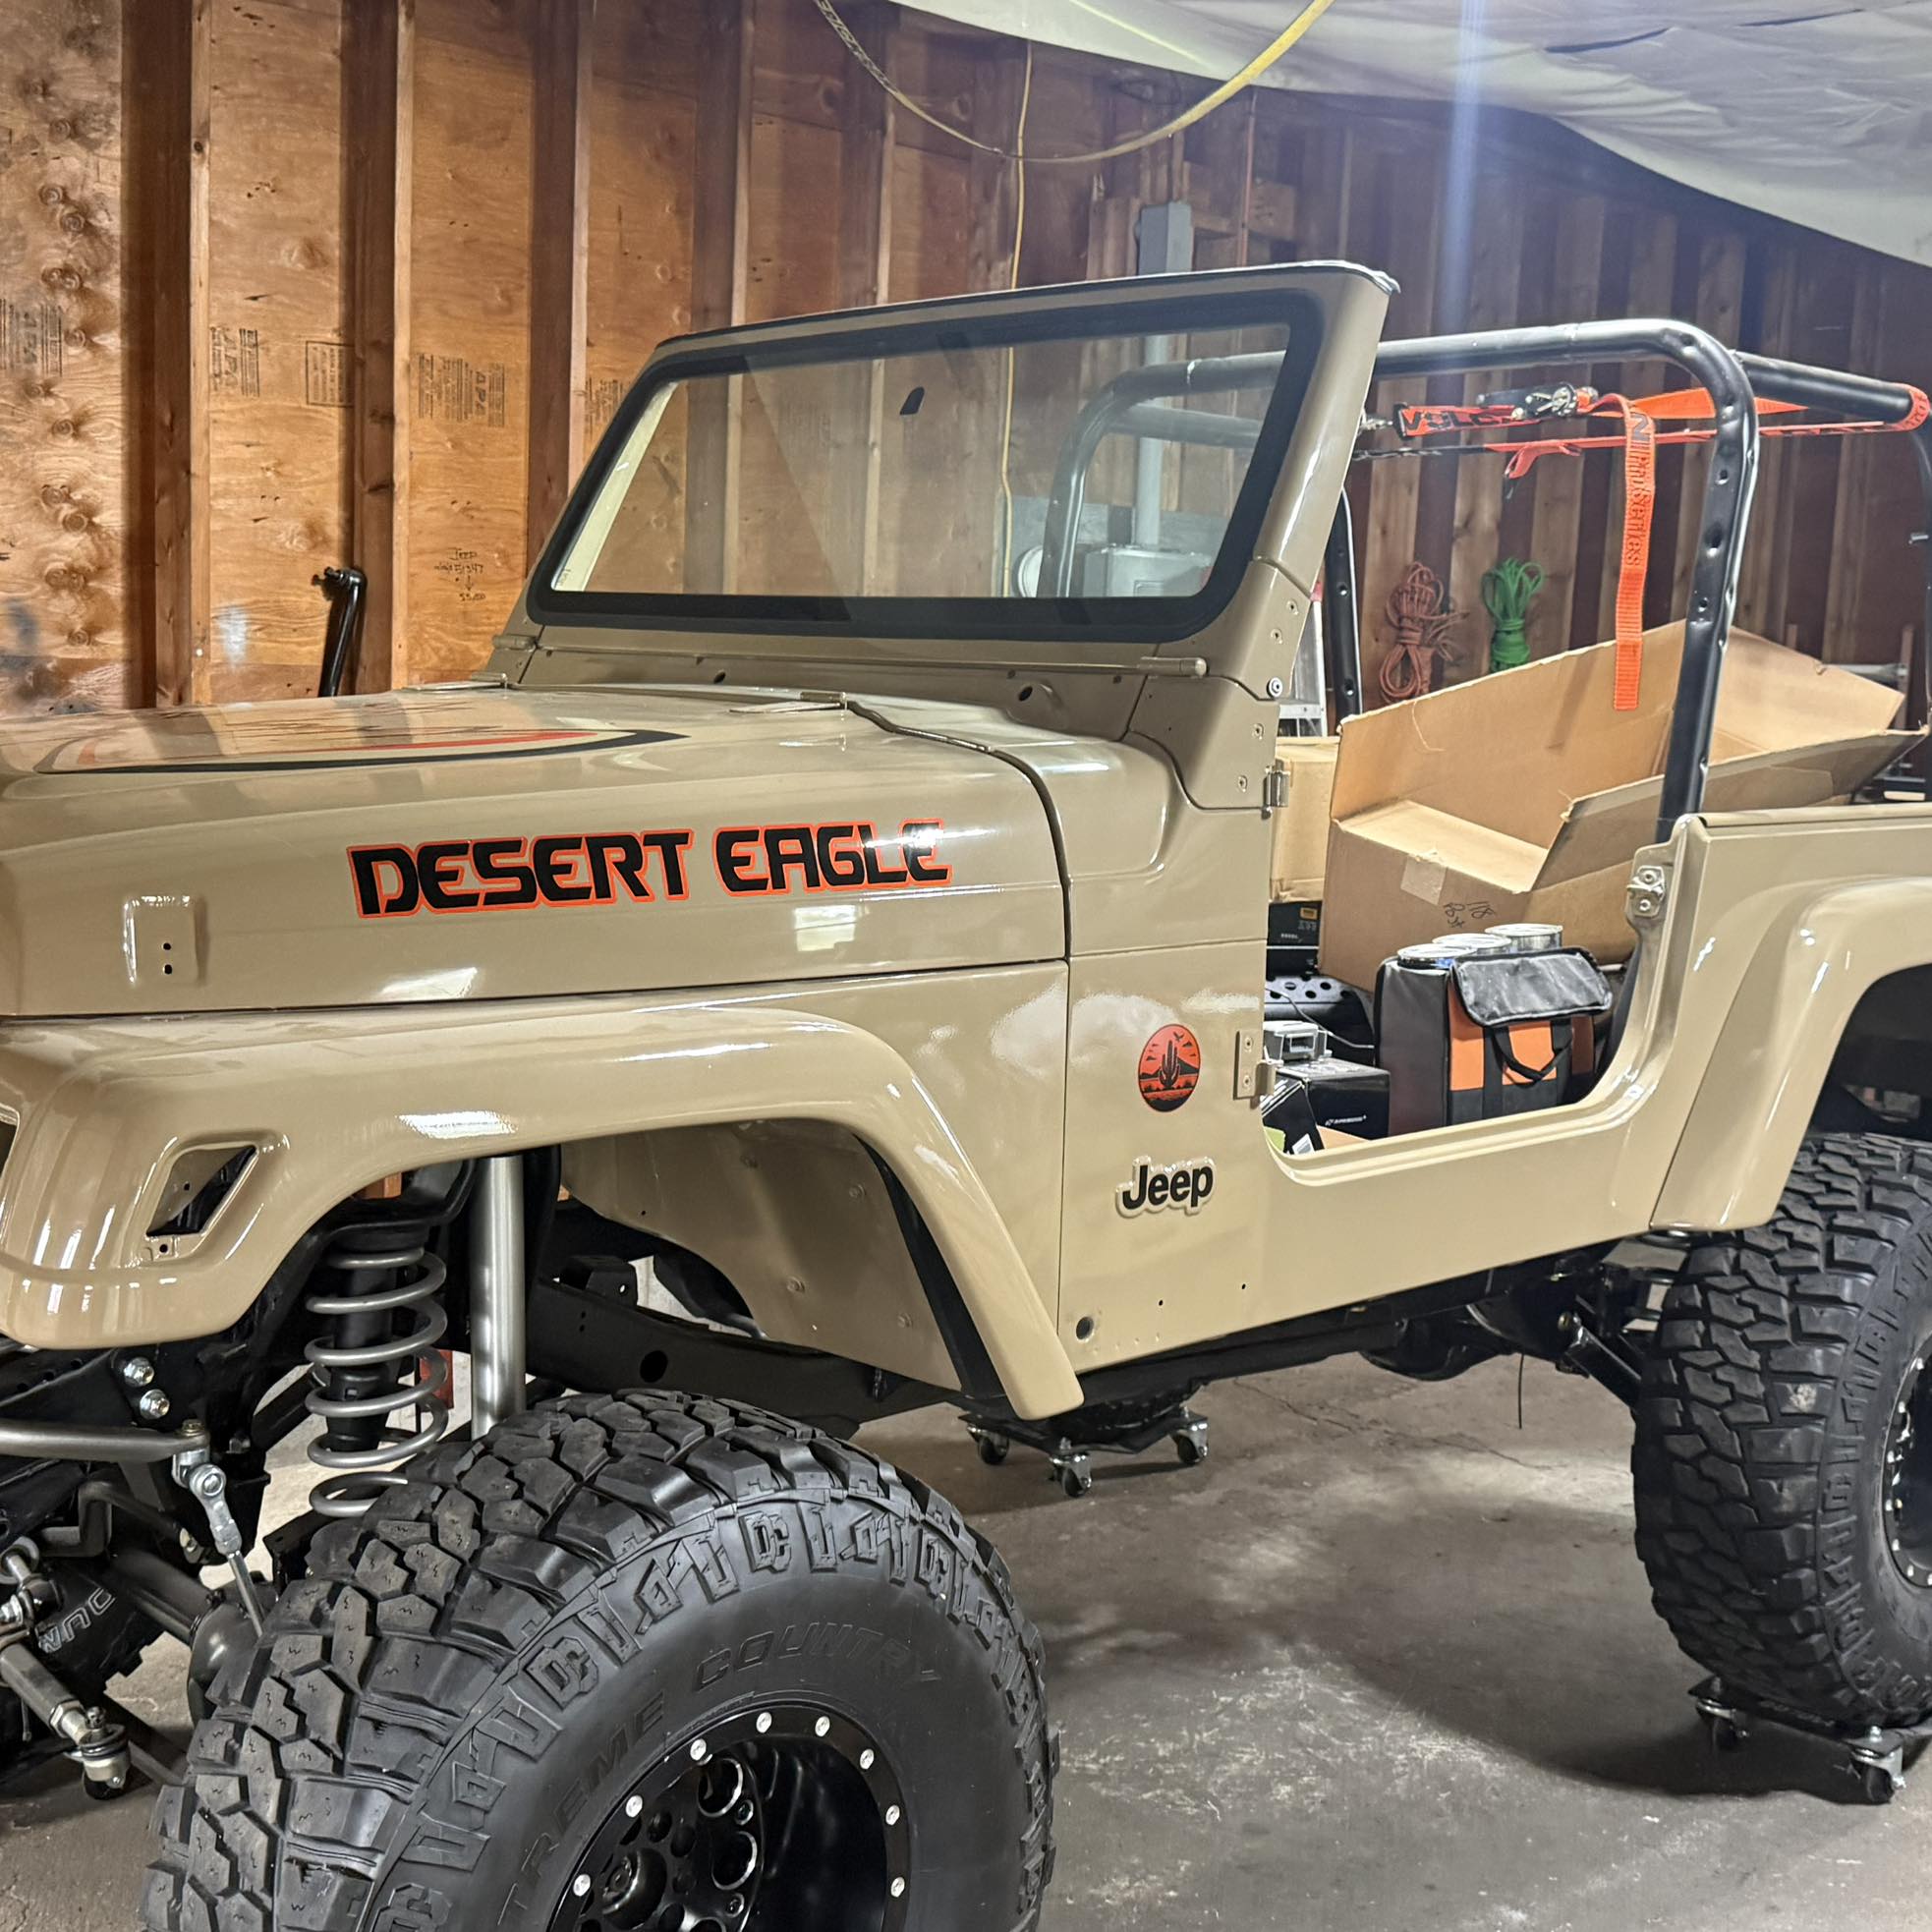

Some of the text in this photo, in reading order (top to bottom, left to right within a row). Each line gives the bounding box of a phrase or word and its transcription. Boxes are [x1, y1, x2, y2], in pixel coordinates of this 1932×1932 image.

[347, 819, 952, 918] DESERT EAGLE
[1122, 1165, 1214, 1210] Jeep
